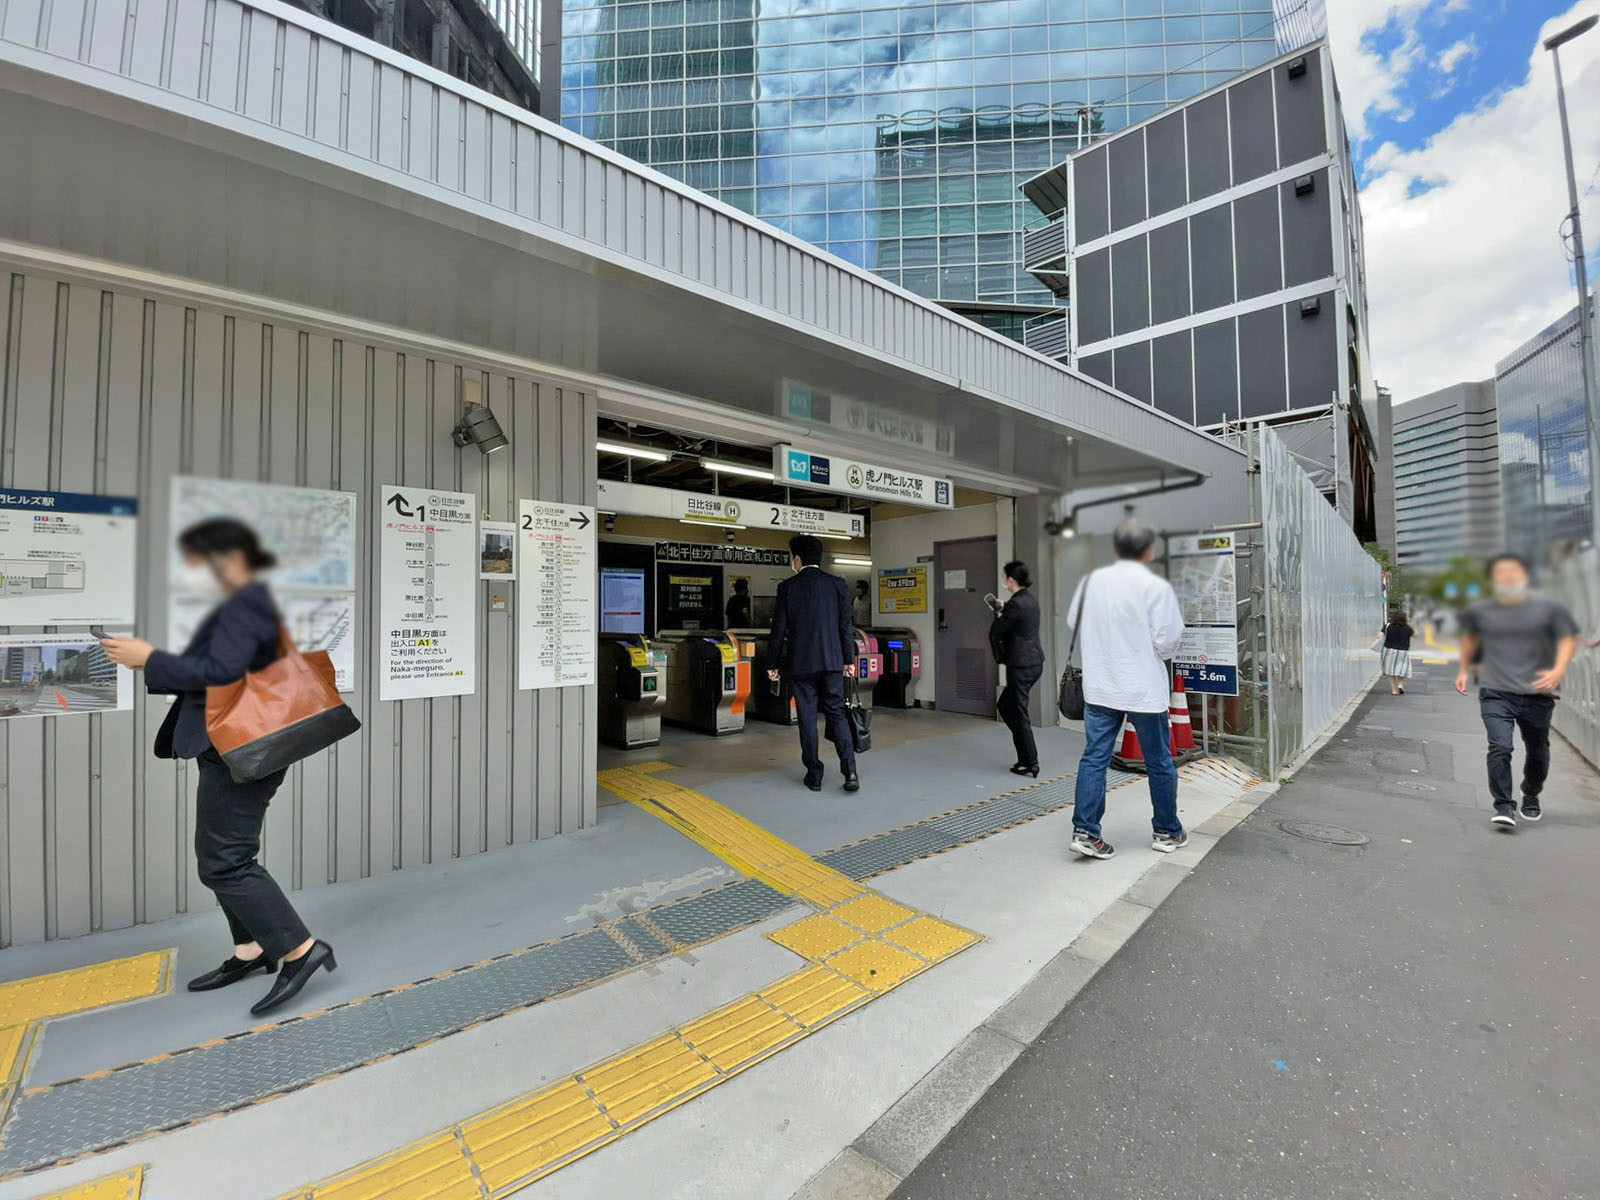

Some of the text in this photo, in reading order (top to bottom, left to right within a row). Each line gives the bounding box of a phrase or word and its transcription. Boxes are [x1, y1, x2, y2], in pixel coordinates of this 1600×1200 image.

[850, 475, 860, 485] 06
[866, 469, 923, 491] 虎ノ門ヒルズ駅
[866, 482, 899, 495] Toranomon
[900, 489, 911, 497] Hills
[441, 497, 465, 505] 日比谷線
[688, 498, 721, 511] 日比谷線
[416, 505, 425, 522] 1
[430, 509, 471, 520] 中目黒方面
[729, 507, 736, 515] H
[770, 507, 780, 525] 2
[791, 509, 824, 521] 北千住方面
[522, 514, 533, 530] 2
[535, 518, 570, 528] 北千住方面
[1213, 538, 1229, 548] A2
[669, 547, 790, 564] 北千住方面専用改札口です
[391, 629, 447, 639] 中目黒方面は
[391, 640, 416, 648] 出入口
[418, 639, 430, 647] A1
[391, 648, 447, 657] ご利用ください
[391, 664, 445, 673] Naka-meguro,
[391, 673, 412, 681] please
[1199, 670, 1227, 682] 5.6m
